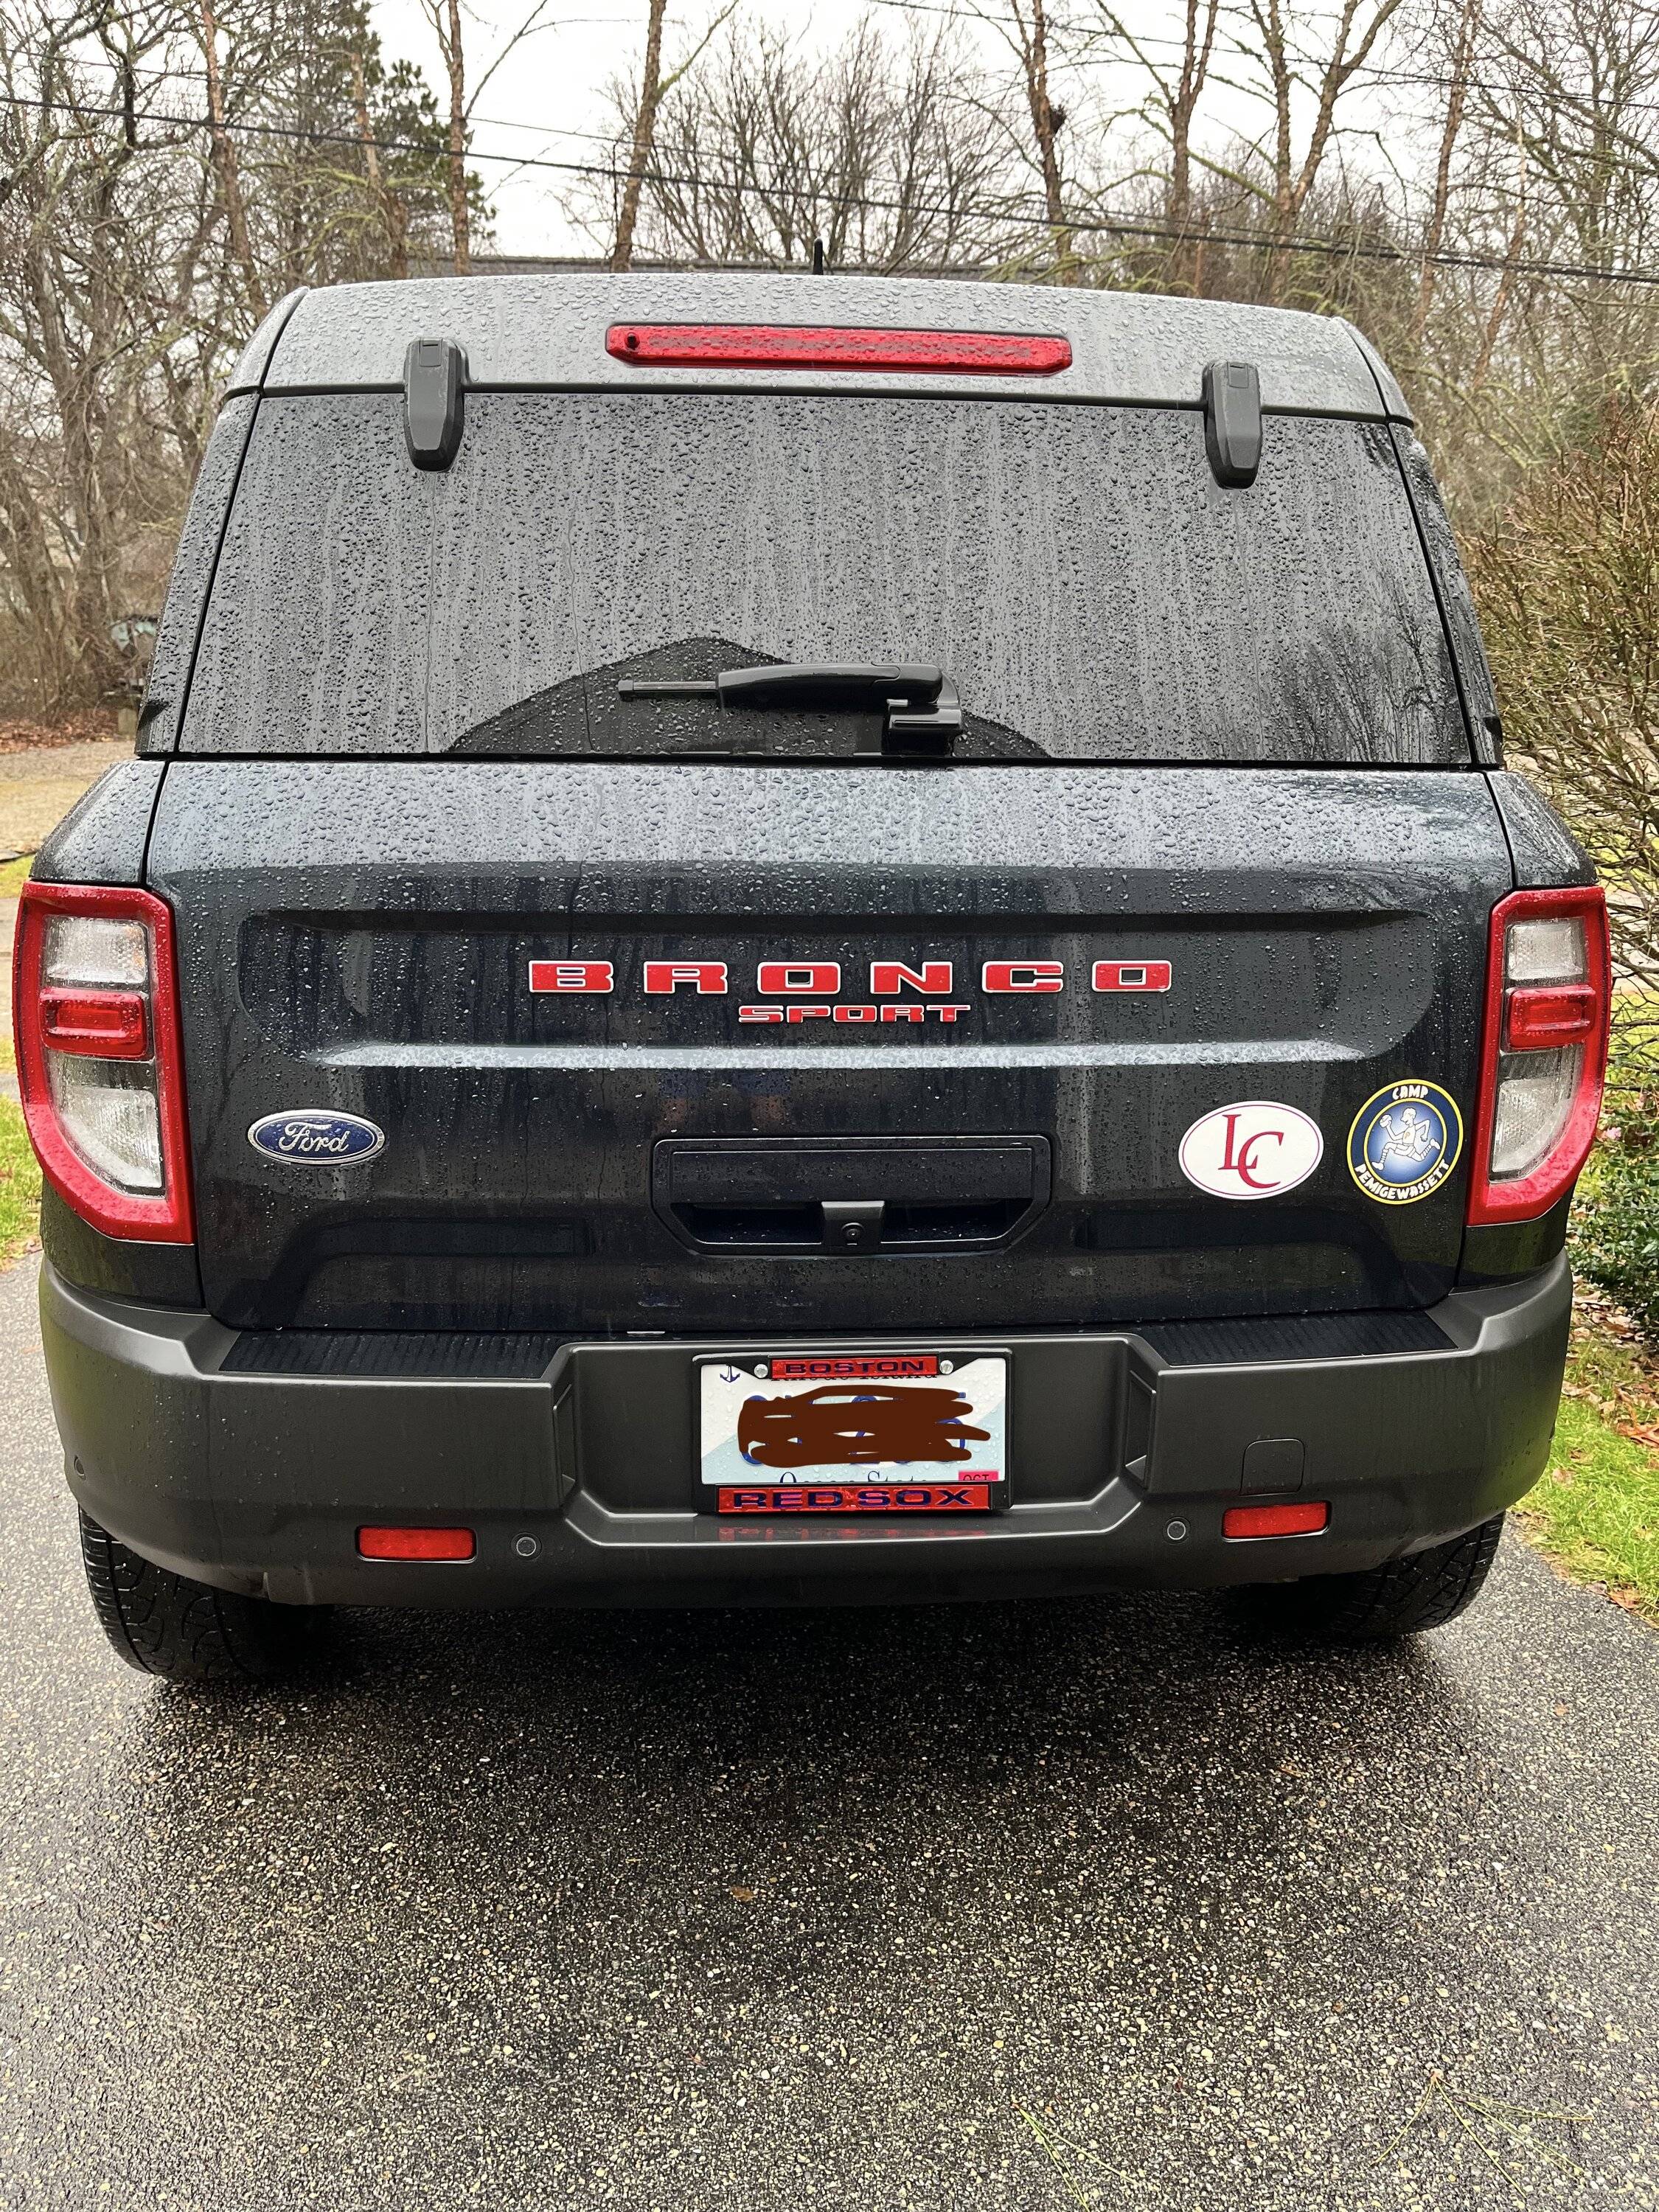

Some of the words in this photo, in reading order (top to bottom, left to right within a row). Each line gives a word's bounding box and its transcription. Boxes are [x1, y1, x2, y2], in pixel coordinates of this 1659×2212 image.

[528, 959, 1173, 995] BRONCO
[737, 1004, 972, 1024] SPORT
[1392, 1085, 1429, 1100] CAMP
[278, 1121, 351, 1152] Ford
[1217, 1114, 1285, 1189] LC
[1354, 1158, 1450, 1200] PEMIGEWASSETT
[785, 1360, 925, 1375] BOSTON
[732, 1489, 844, 1509] RED
[856, 1487, 974, 1506] SOX
